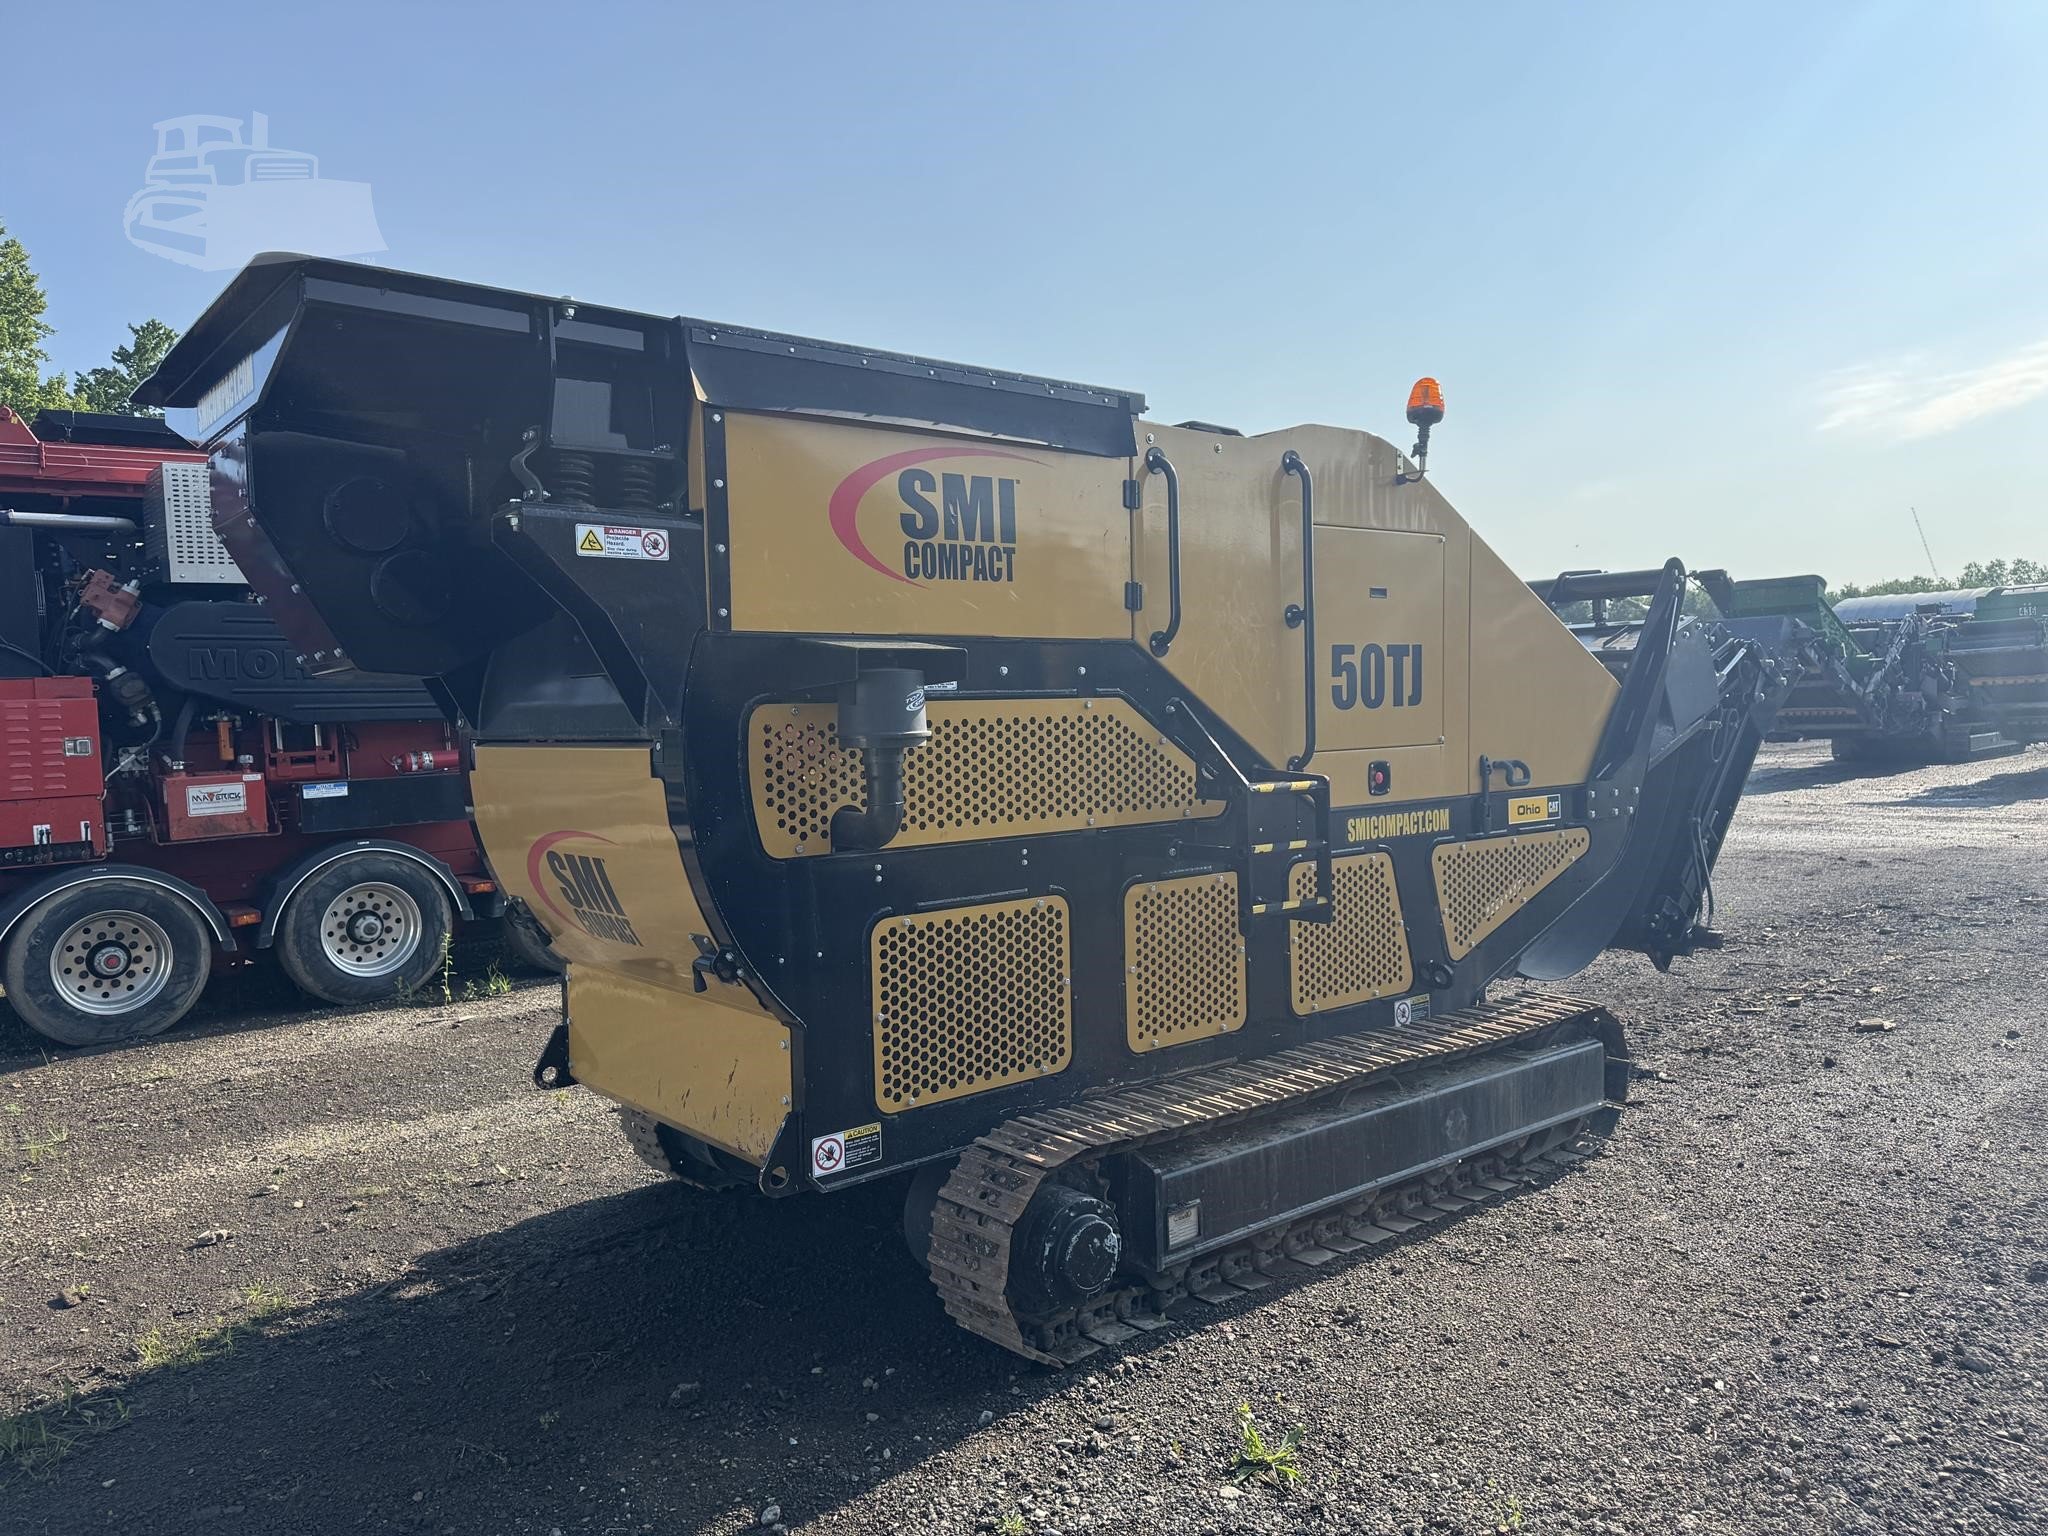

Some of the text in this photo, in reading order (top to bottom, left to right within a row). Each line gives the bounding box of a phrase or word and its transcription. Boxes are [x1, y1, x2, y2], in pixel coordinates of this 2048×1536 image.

[898, 468, 1016, 544] SMI
[904, 540, 1016, 582] COMPACT
[1331, 643, 1422, 710] 50TJ
[192, 792, 241, 801] MAVERICK
[1517, 801, 1559, 815] Ohio CAT
[1347, 809, 1449, 842] SMICOMPACT.COM
[546, 850, 627, 917] SMI
[574, 908, 644, 947] COMPACT
[853, 1126, 878, 1137] CAUTION
